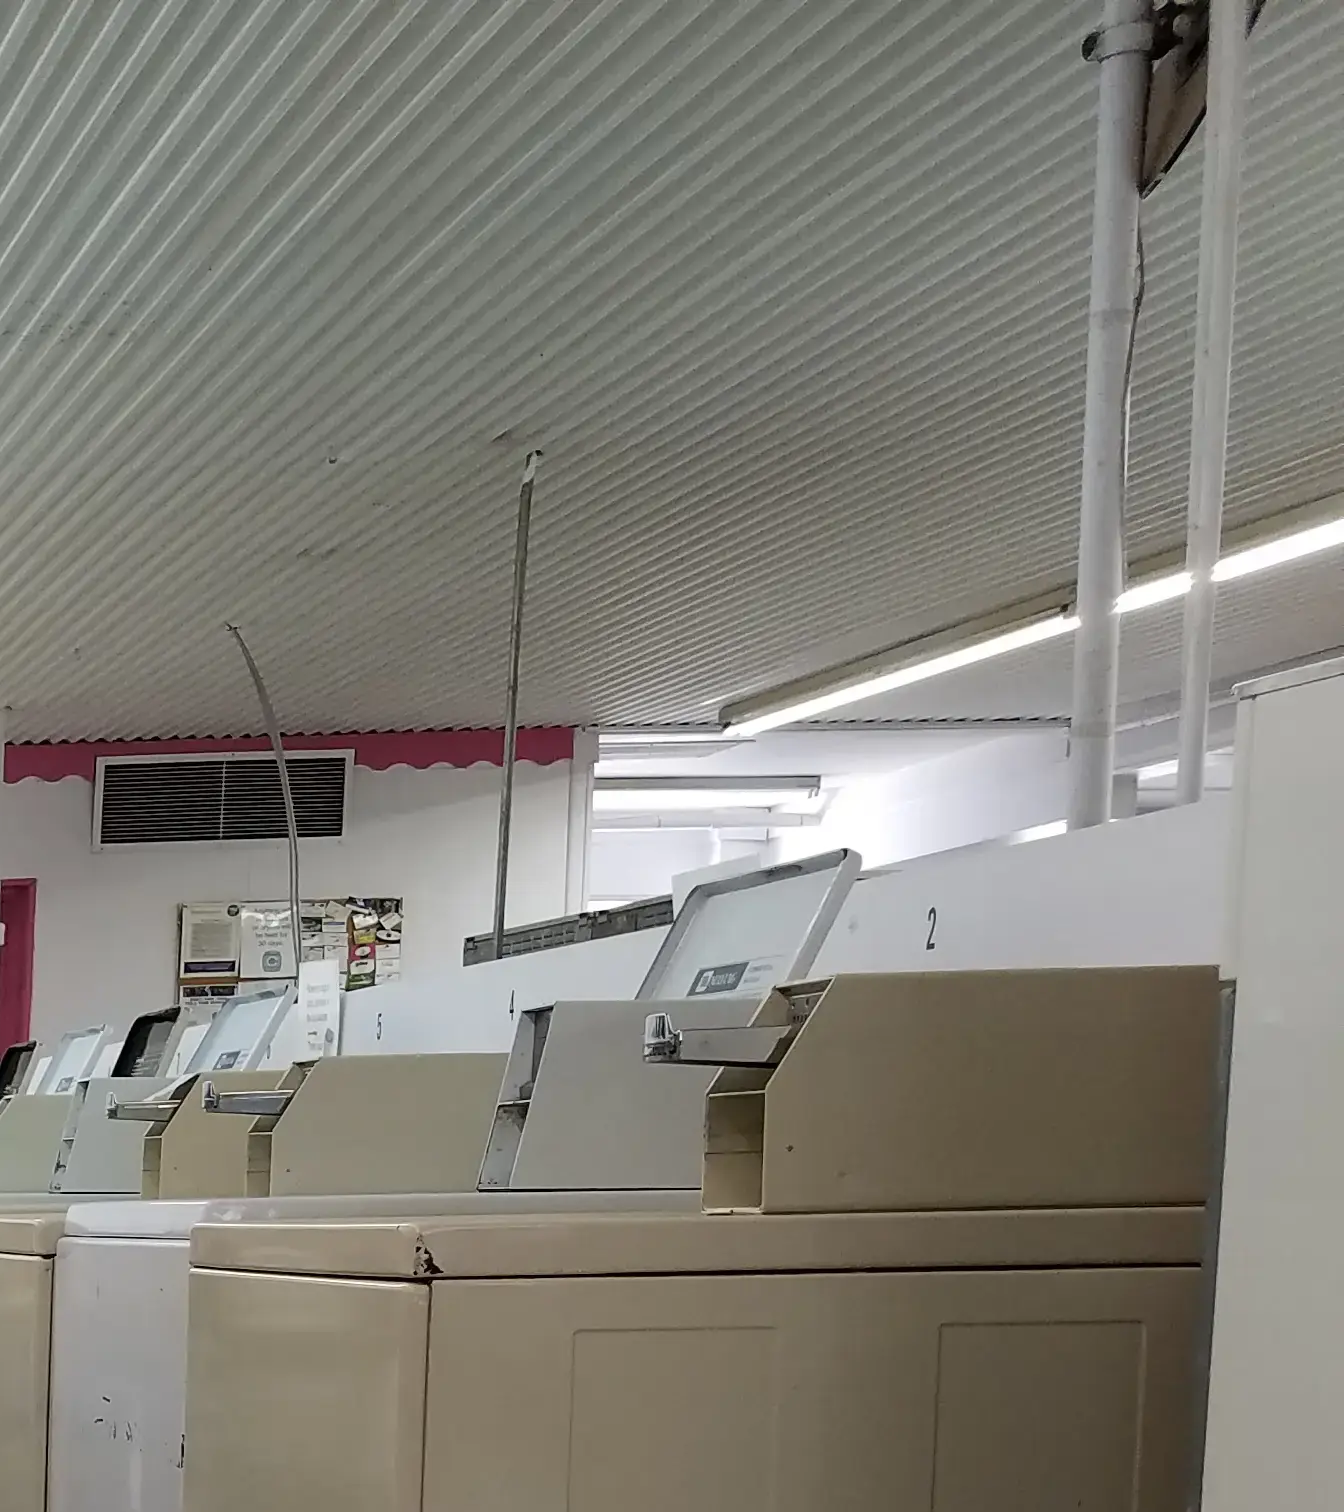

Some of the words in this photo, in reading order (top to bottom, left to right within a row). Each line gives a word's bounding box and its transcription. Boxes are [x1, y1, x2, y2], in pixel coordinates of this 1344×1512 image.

[926, 906, 937, 951] 2
[509, 989, 515, 1021] 4
[376, 1012, 382, 1041] 5
